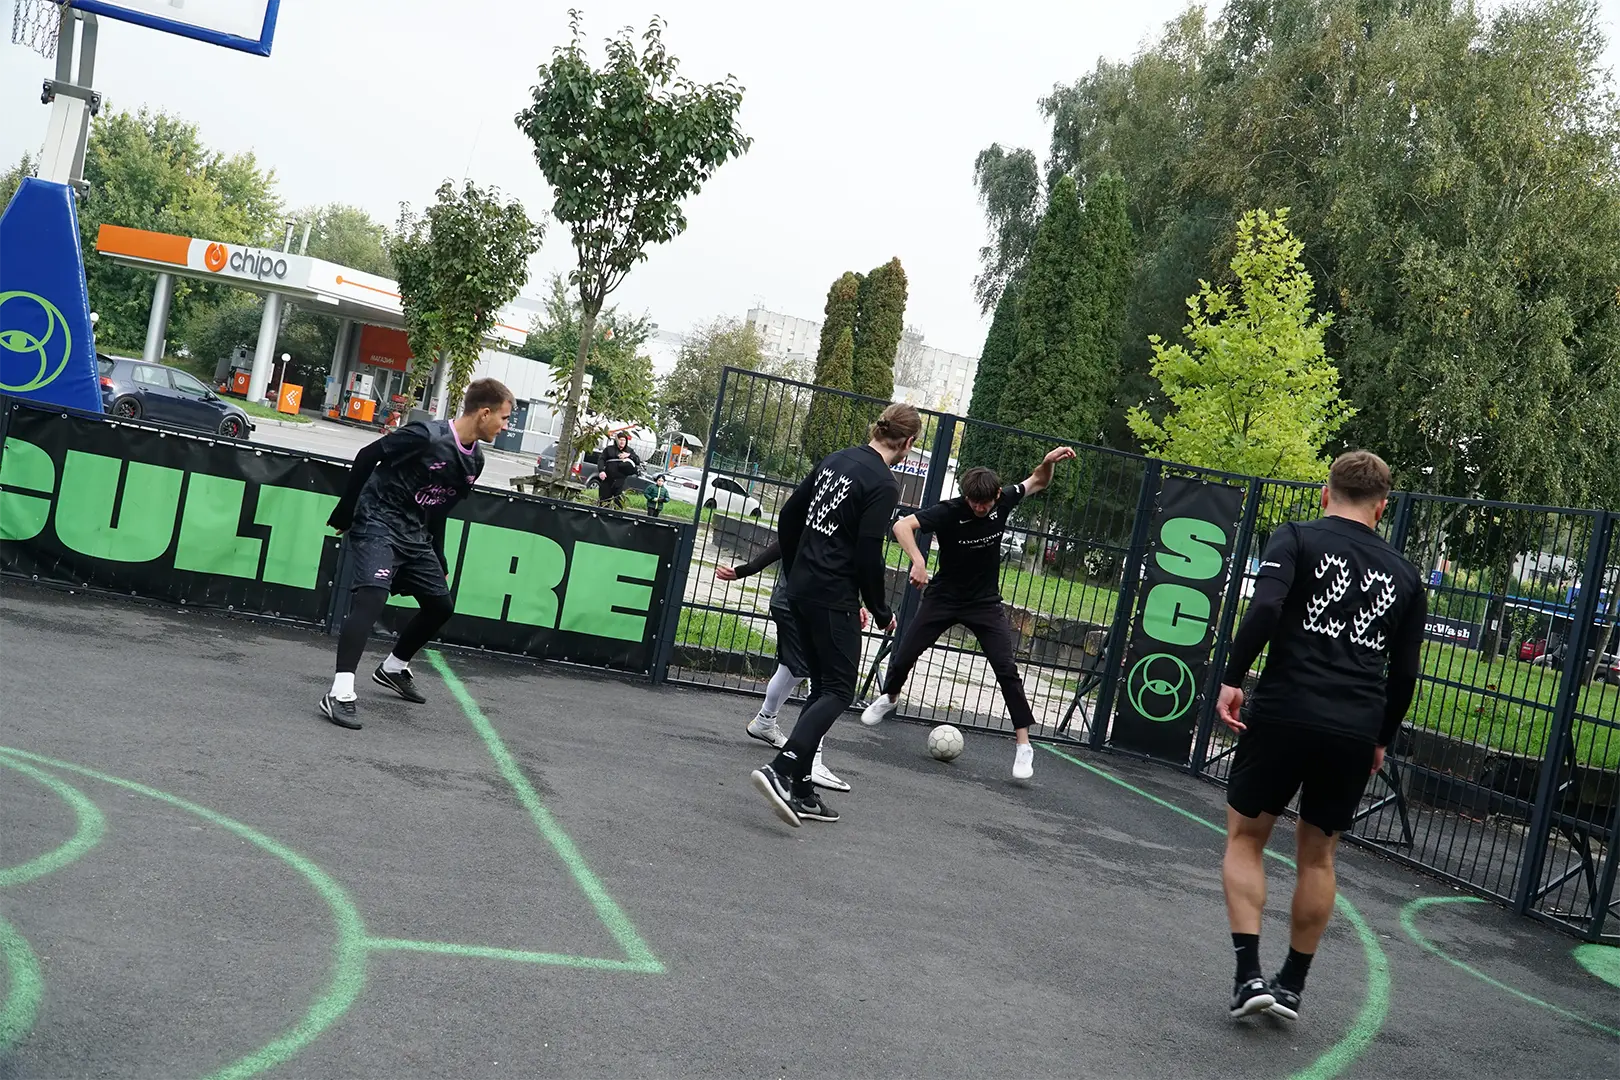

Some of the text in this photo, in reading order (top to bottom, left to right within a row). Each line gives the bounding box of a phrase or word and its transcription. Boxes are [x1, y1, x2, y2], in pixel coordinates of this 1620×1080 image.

[230, 248, 288, 280] chipo
[370, 354, 395, 366] МАГАЗИН
[1303, 553, 1397, 651] 22
